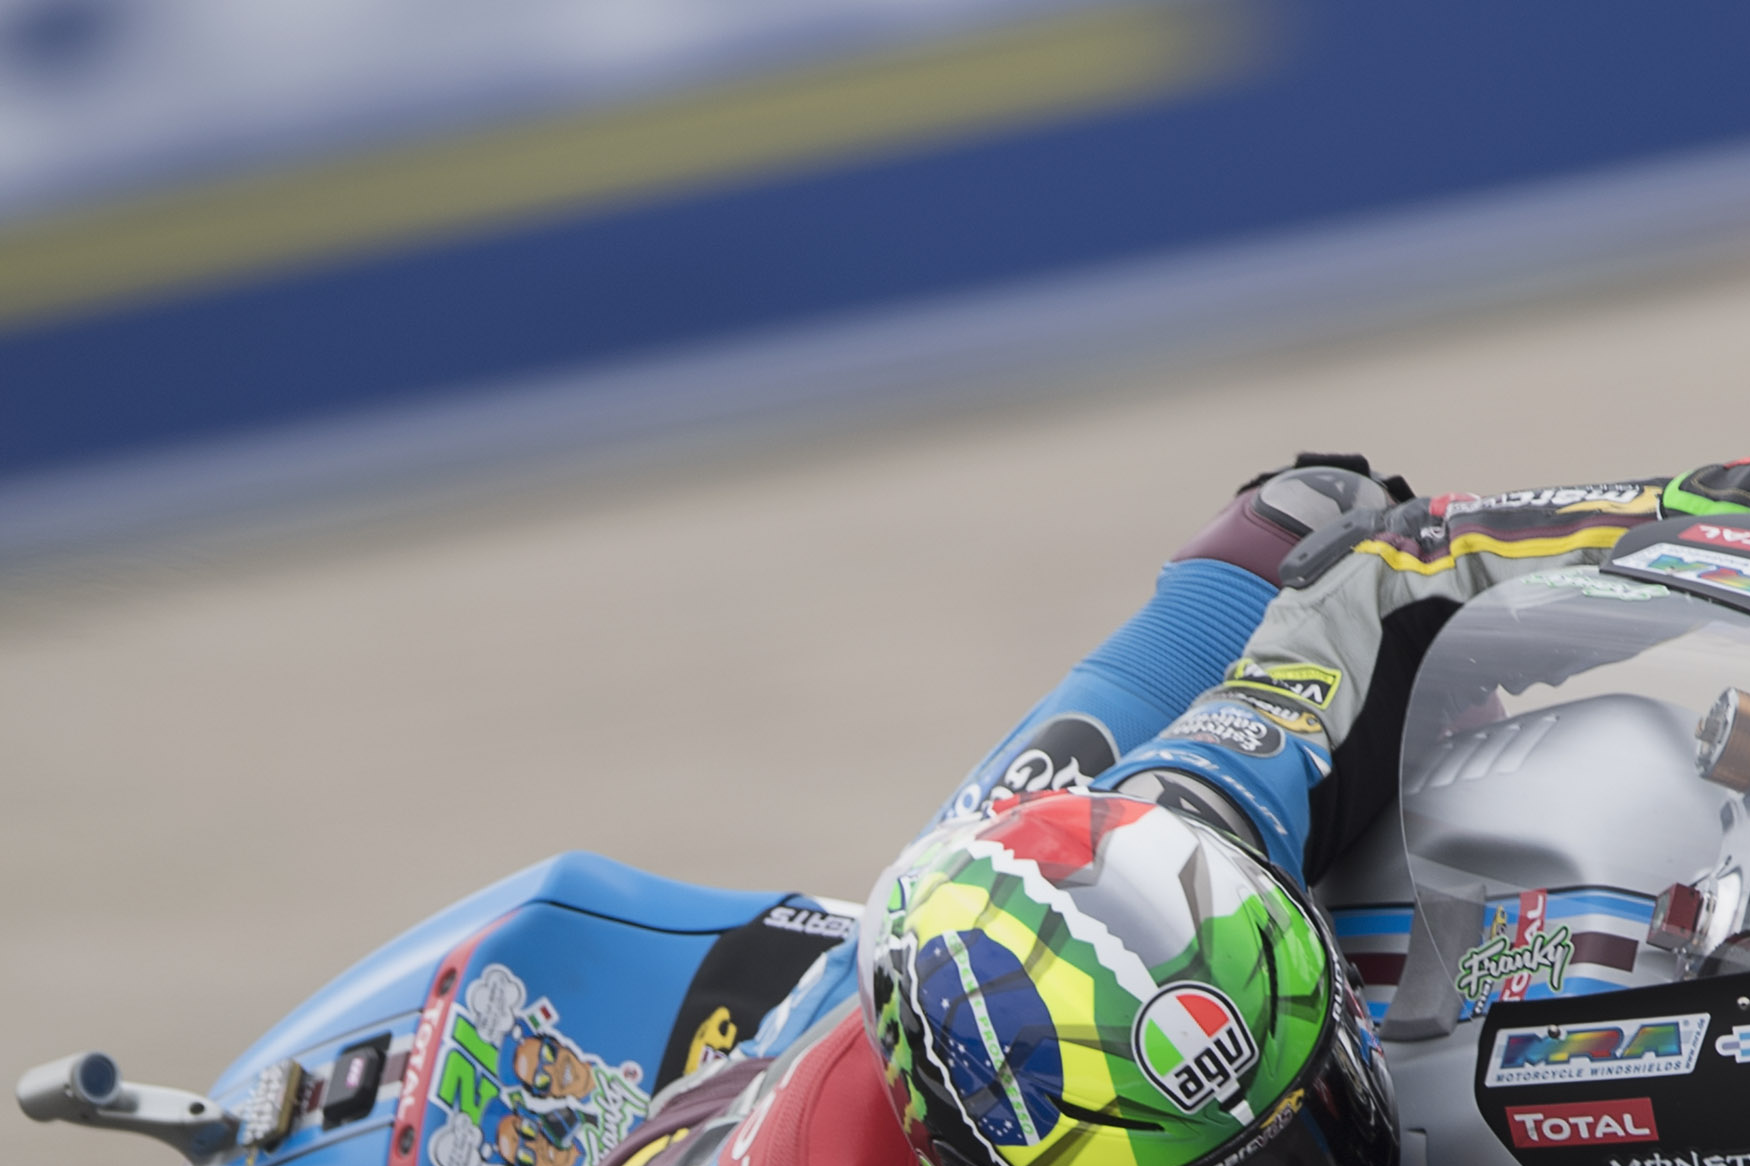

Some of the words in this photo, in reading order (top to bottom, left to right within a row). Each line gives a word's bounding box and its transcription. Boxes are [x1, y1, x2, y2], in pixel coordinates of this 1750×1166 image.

[1458, 926, 1573, 1001] Franky
[1502, 894, 1545, 1002] TOAL
[1173, 1027, 1245, 1101] agv
[1495, 1067, 1585, 1083] MOTORCYCLE
[1590, 1059, 1683, 1077] WINDSHIELDS
[1500, 1020, 1682, 1070] MRA
[1514, 1112, 1651, 1143] TOTAL
